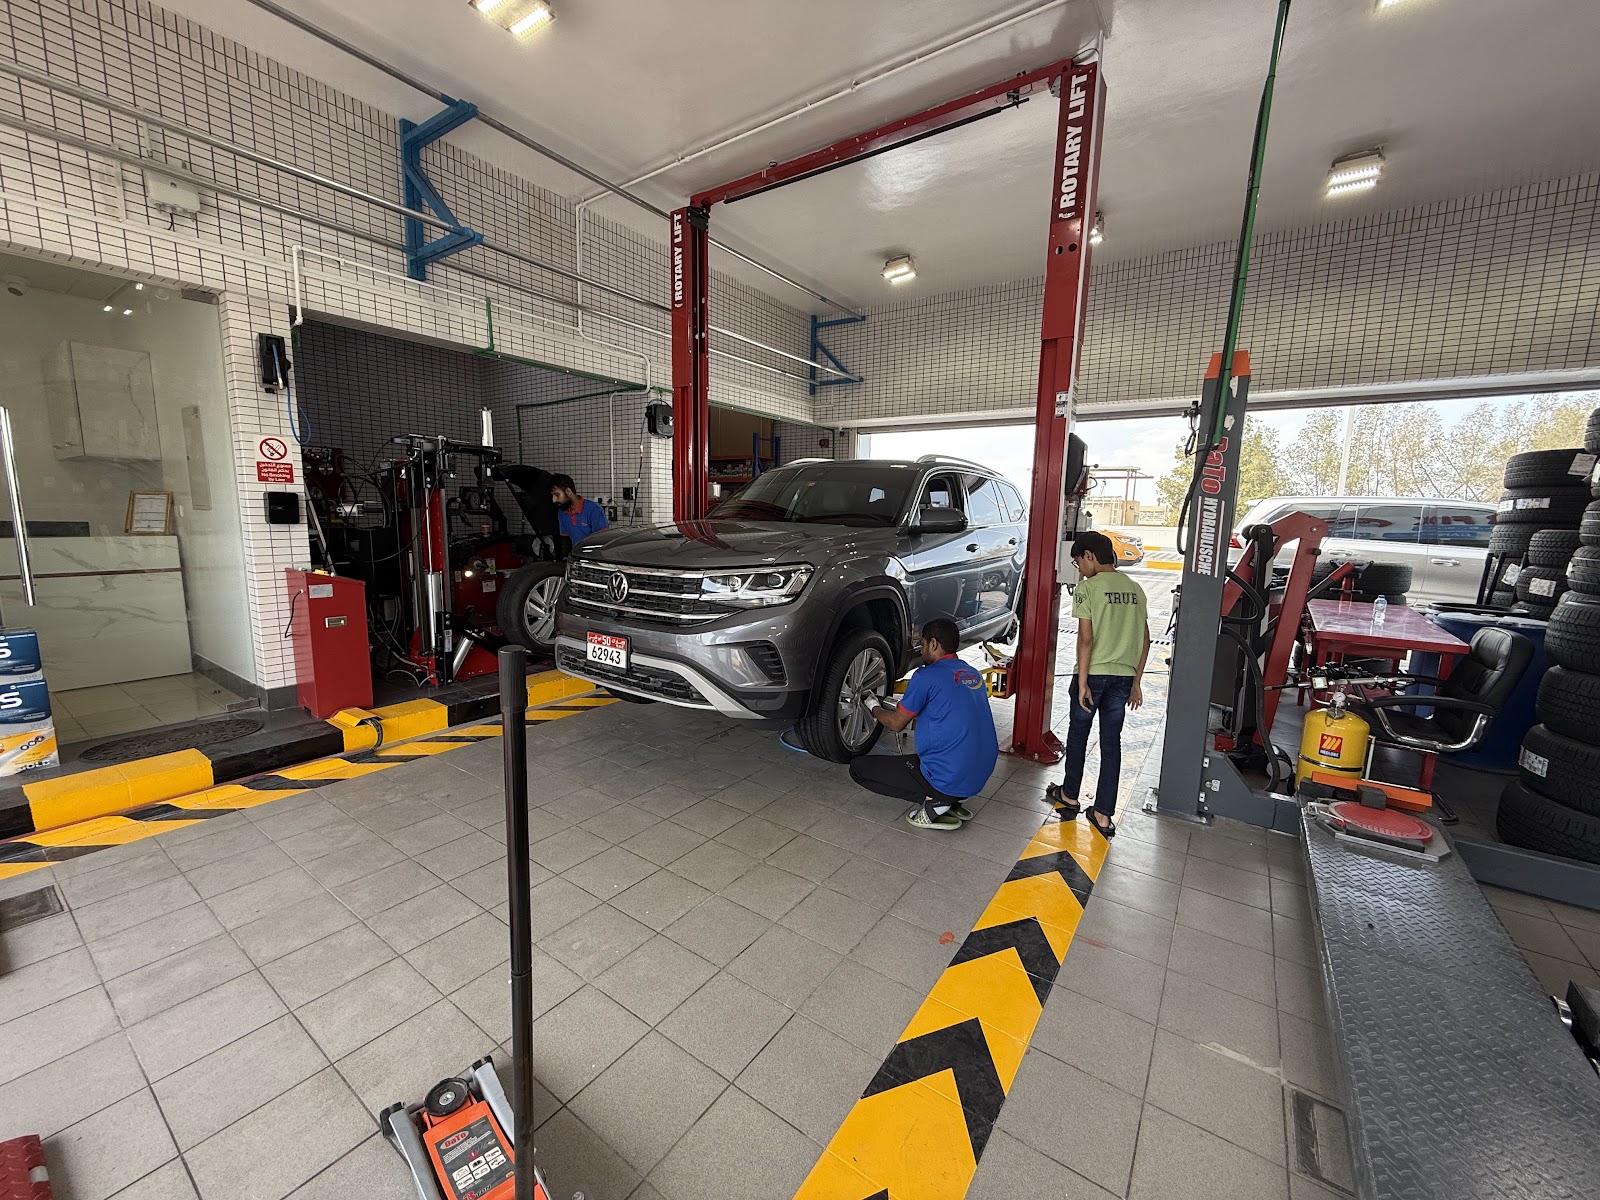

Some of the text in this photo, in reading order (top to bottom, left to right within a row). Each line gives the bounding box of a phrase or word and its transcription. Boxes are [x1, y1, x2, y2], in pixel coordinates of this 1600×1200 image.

[1068, 73, 1089, 120] LIFT
[1060, 125, 1083, 209] ROTARY
[673, 213, 683, 301] ROTARY LIFT
[1197, 496, 1219, 577] HYDRAULISCHE
[1105, 591, 1138, 605] TRUE
[591, 645, 621, 665] 62943
[602, 635, 611, 646] 50
